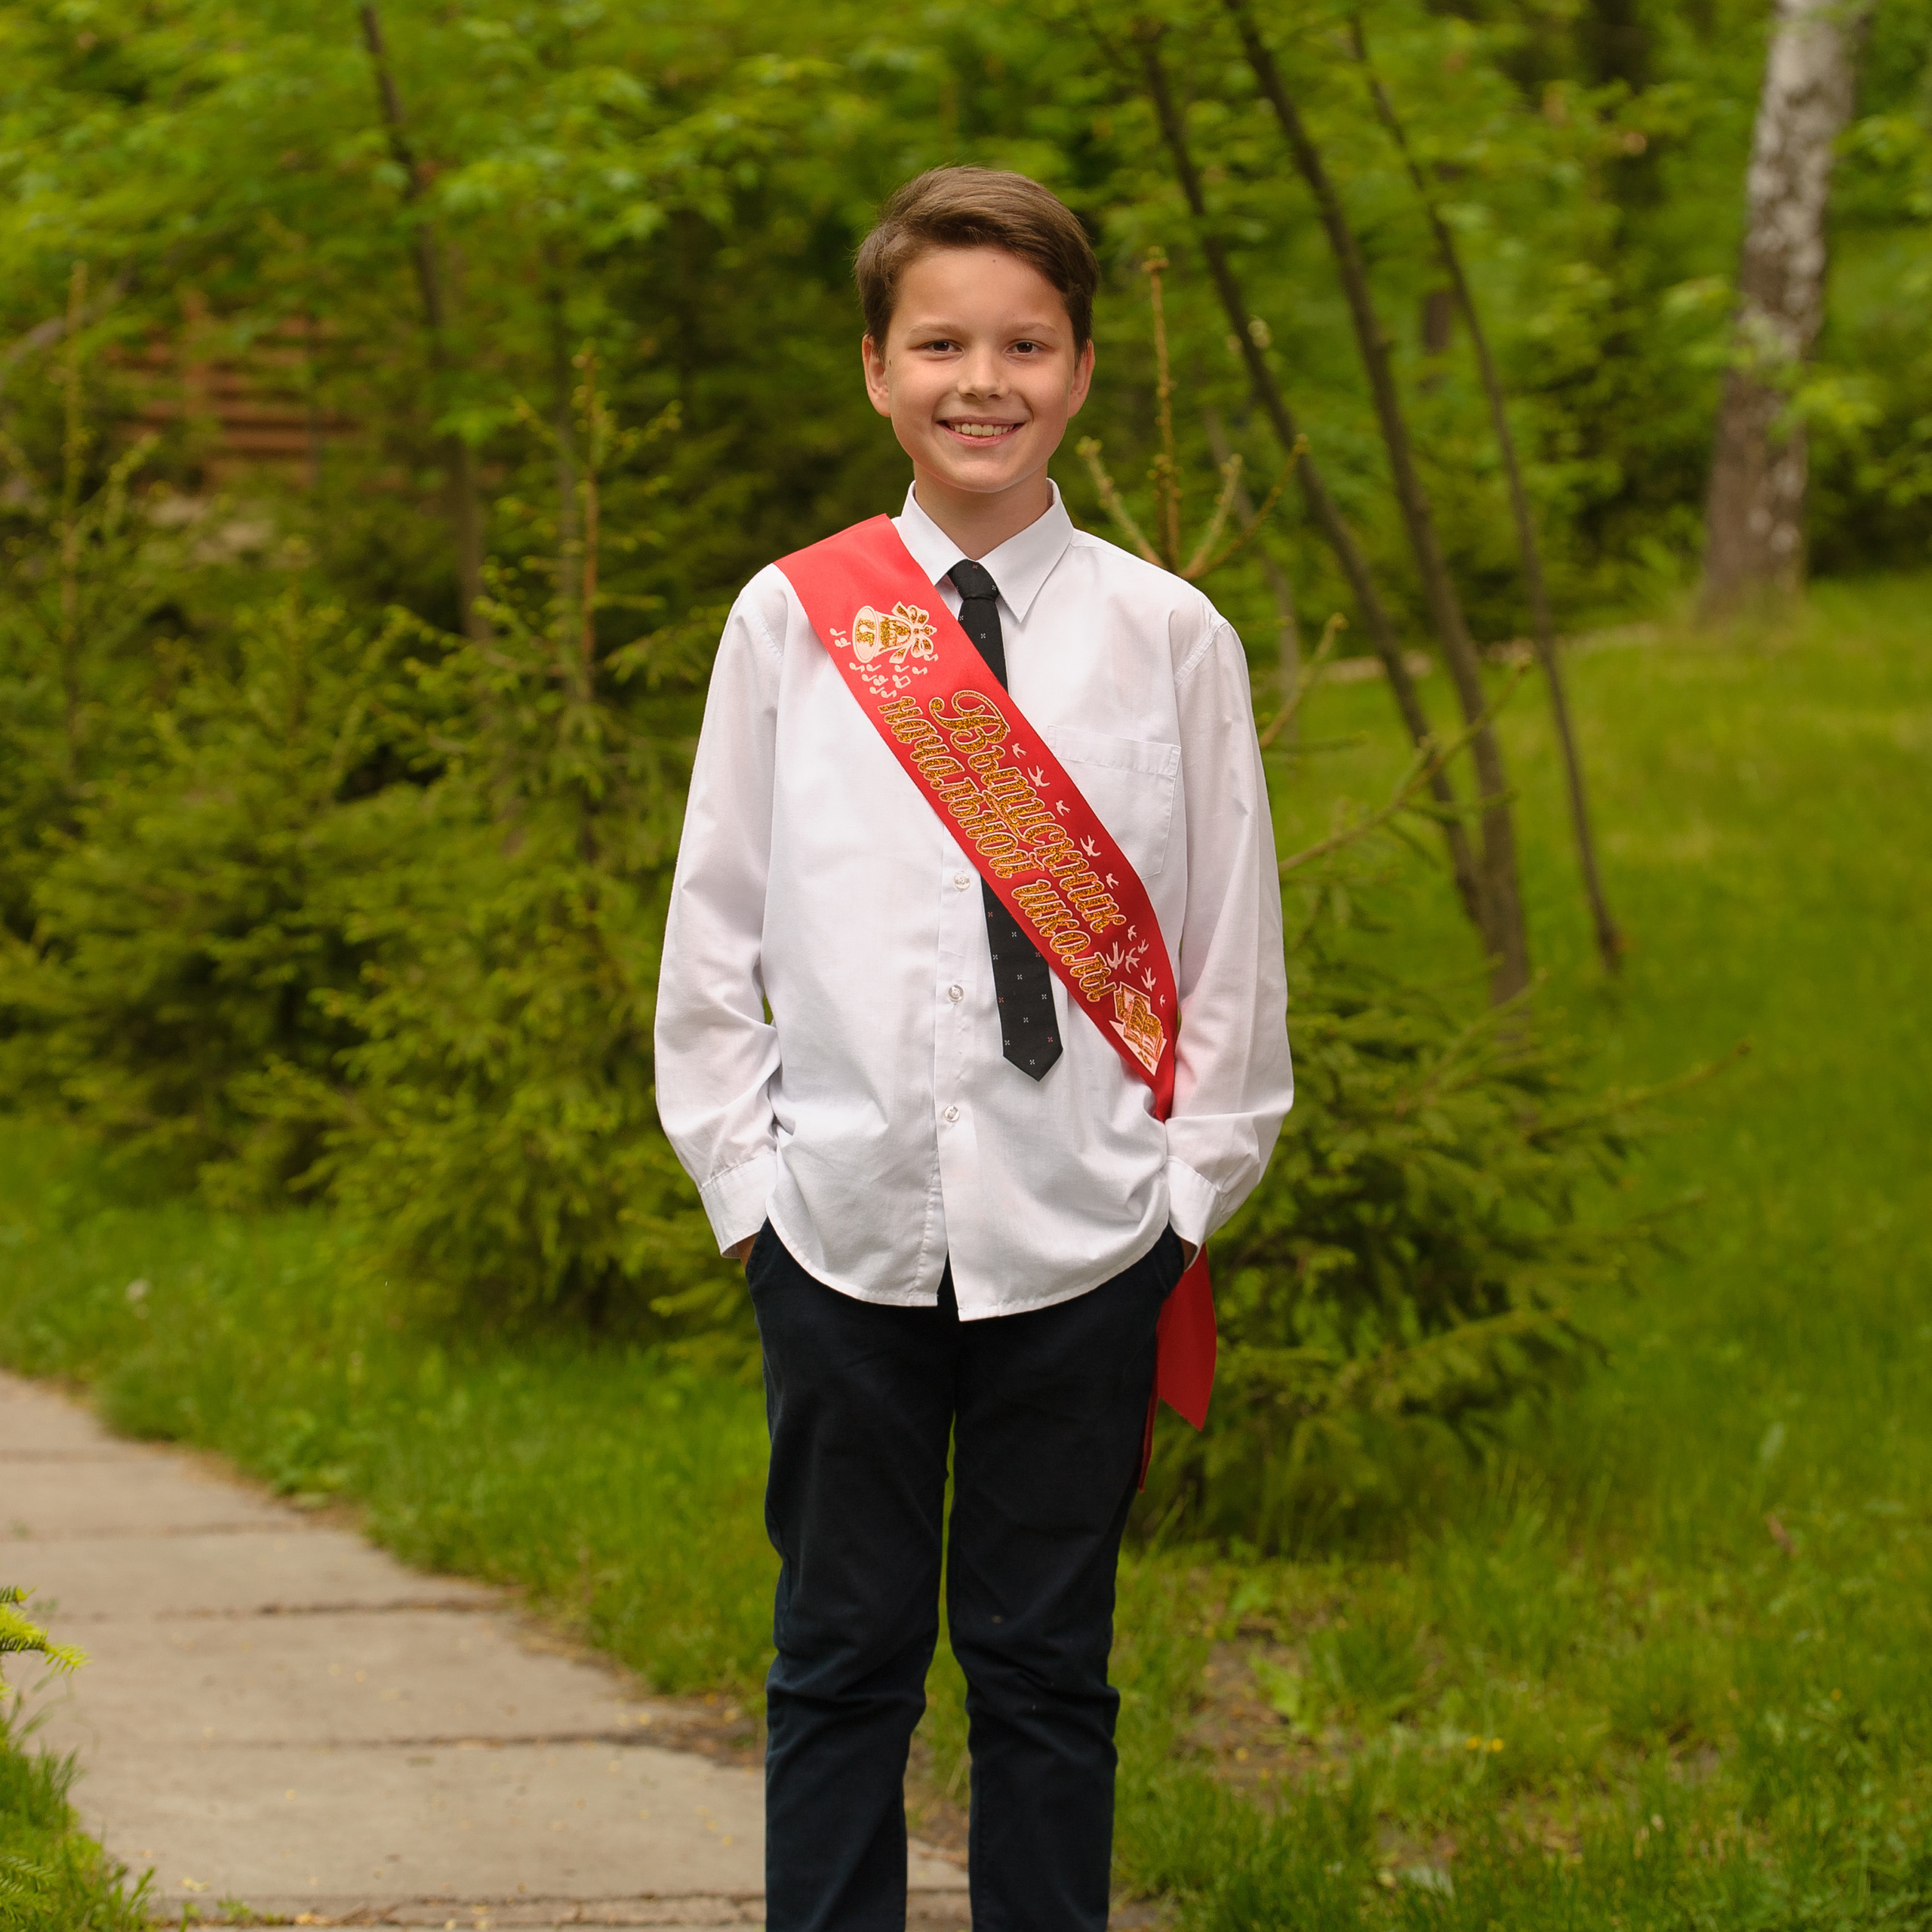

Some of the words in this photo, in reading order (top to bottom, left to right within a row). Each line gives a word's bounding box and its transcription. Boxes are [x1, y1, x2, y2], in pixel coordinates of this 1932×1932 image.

[878, 696, 1044, 878] начальной
[1011, 879, 1116, 1002] школы
[929, 690, 1126, 934] Выпускник
